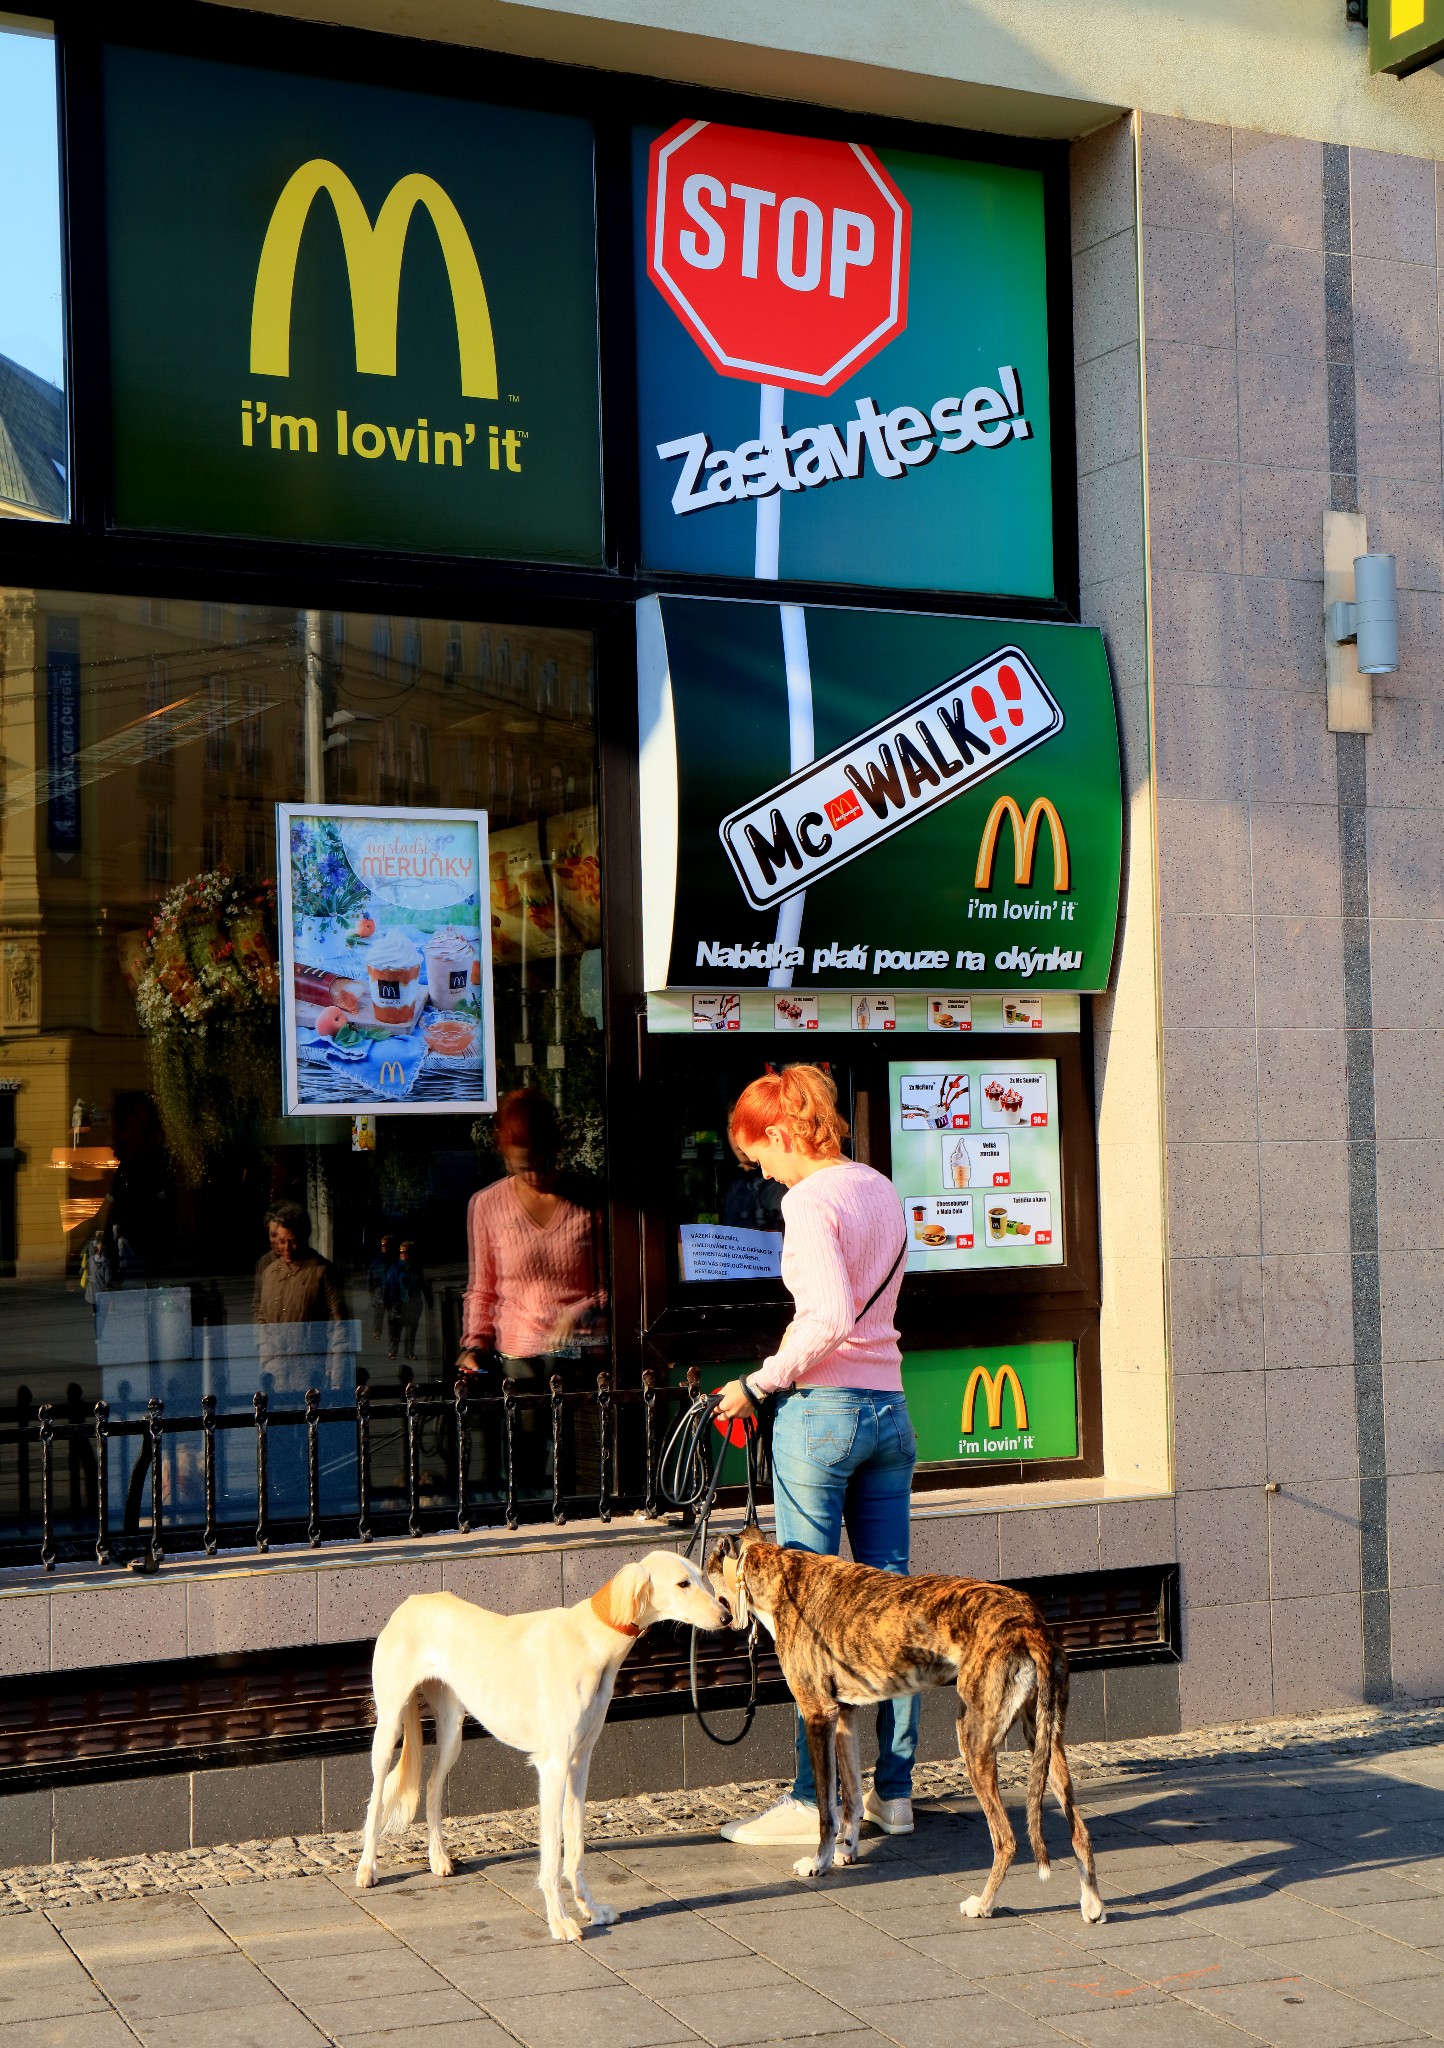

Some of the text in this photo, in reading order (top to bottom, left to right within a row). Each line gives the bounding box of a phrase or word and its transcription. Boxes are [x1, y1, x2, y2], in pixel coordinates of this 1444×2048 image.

[679, 173, 876, 299] STOP
[241, 399, 318, 453] i'm
[337, 409, 476, 467] lovin'
[361, 853, 473, 877] MERUŇKY
[967, 898, 997, 918] i'm
[1003, 899, 1057, 920] lovin'
[695, 941, 1082, 978] Nabídka platí pouze na okýnku
[955, 1117, 964, 1126] 80
[1033, 1116, 1042, 1124] 50
[995, 1175, 1004, 1184] 20
[958, 1237, 967, 1246] 35
[1037, 1233, 1045, 1242] 35
[958, 1439, 980, 1454] i'm
[983, 1435, 1021, 1453] lovin'
